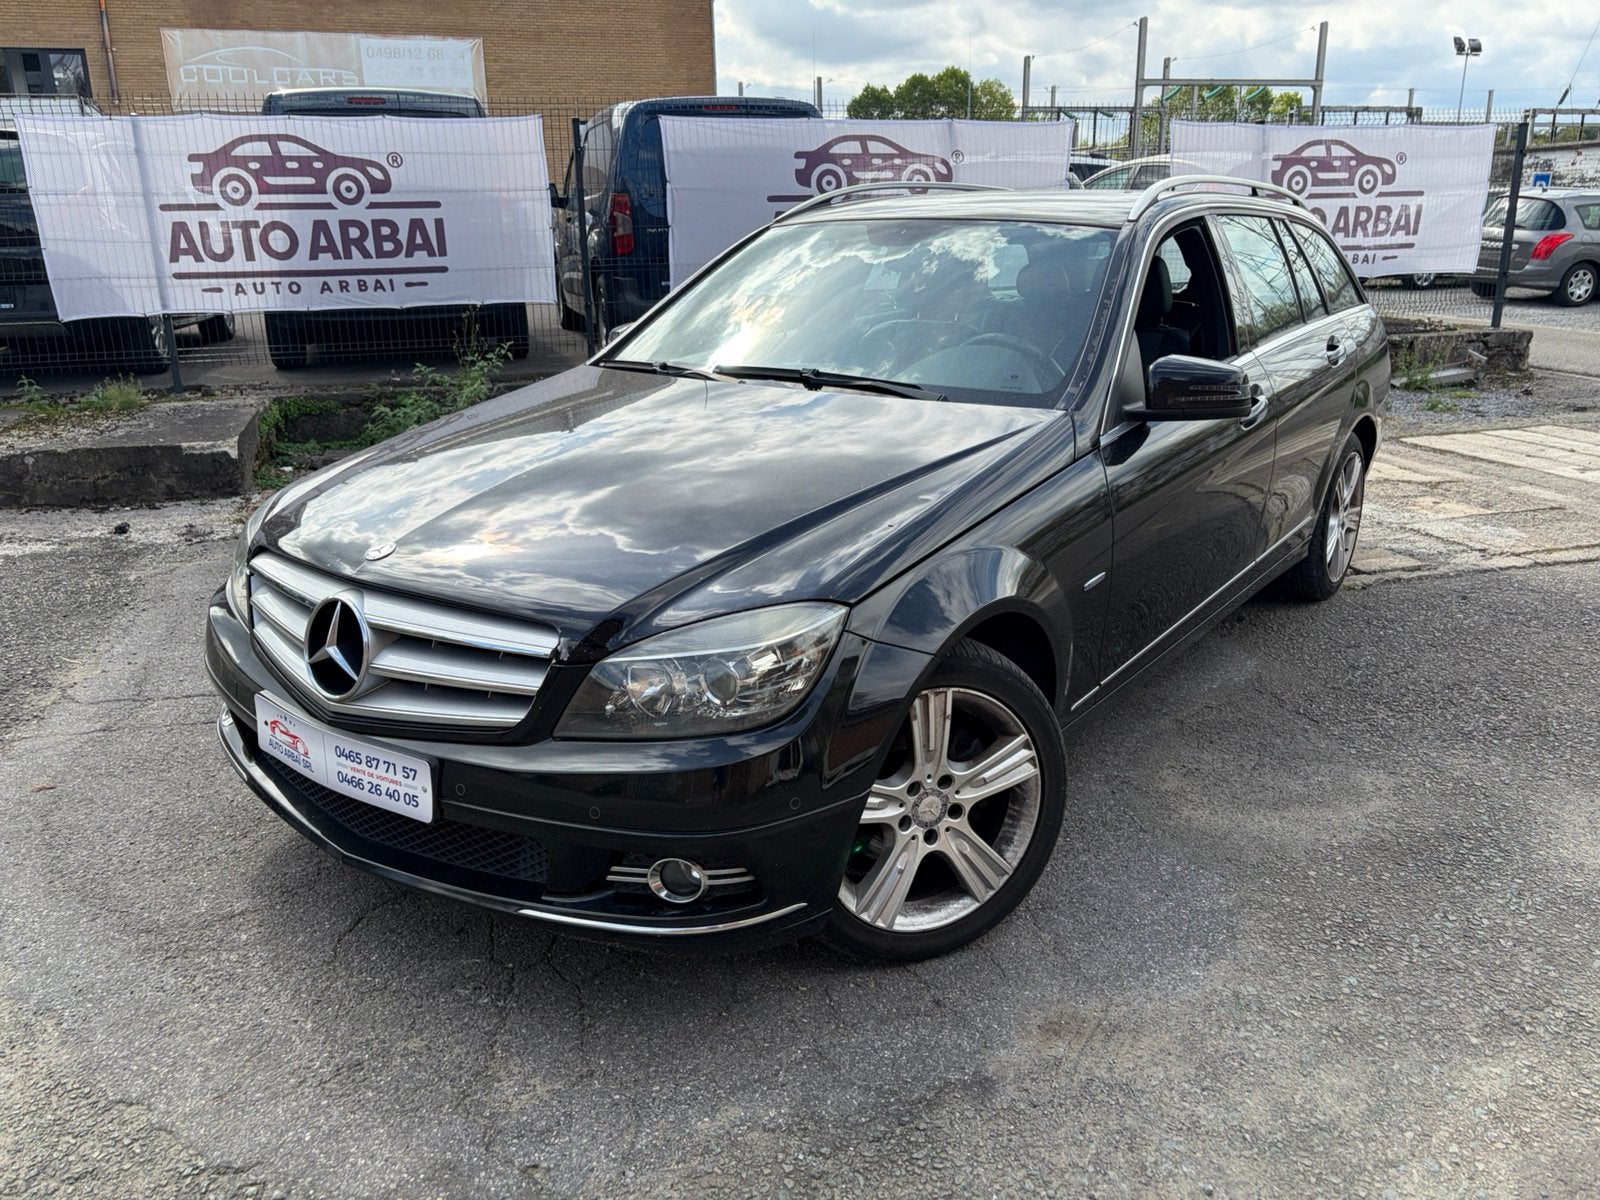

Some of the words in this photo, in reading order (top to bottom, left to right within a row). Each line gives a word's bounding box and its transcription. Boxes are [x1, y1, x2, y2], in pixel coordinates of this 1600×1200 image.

[1330, 204, 1423, 238] ARBAI
[169, 220, 299, 263] AUTO
[309, 218, 448, 261] ARBAI
[234, 281, 302, 296] AUTO
[320, 278, 395, 294] ARBAI
[268, 738, 284, 754] AUTO
[334, 745, 363, 766] 0465
[365, 755, 380, 770] 87
[382, 760, 397, 776] 71
[402, 765, 418, 781] 57
[337, 770, 365, 791] 0466
[367, 781, 383, 797] 26
[384, 786, 401, 802] 40
[403, 791, 419, 808] 05
[350, 765, 366, 776] VENTE
[367, 771, 375, 779] DE
[375, 773, 403, 787] VOITURES
